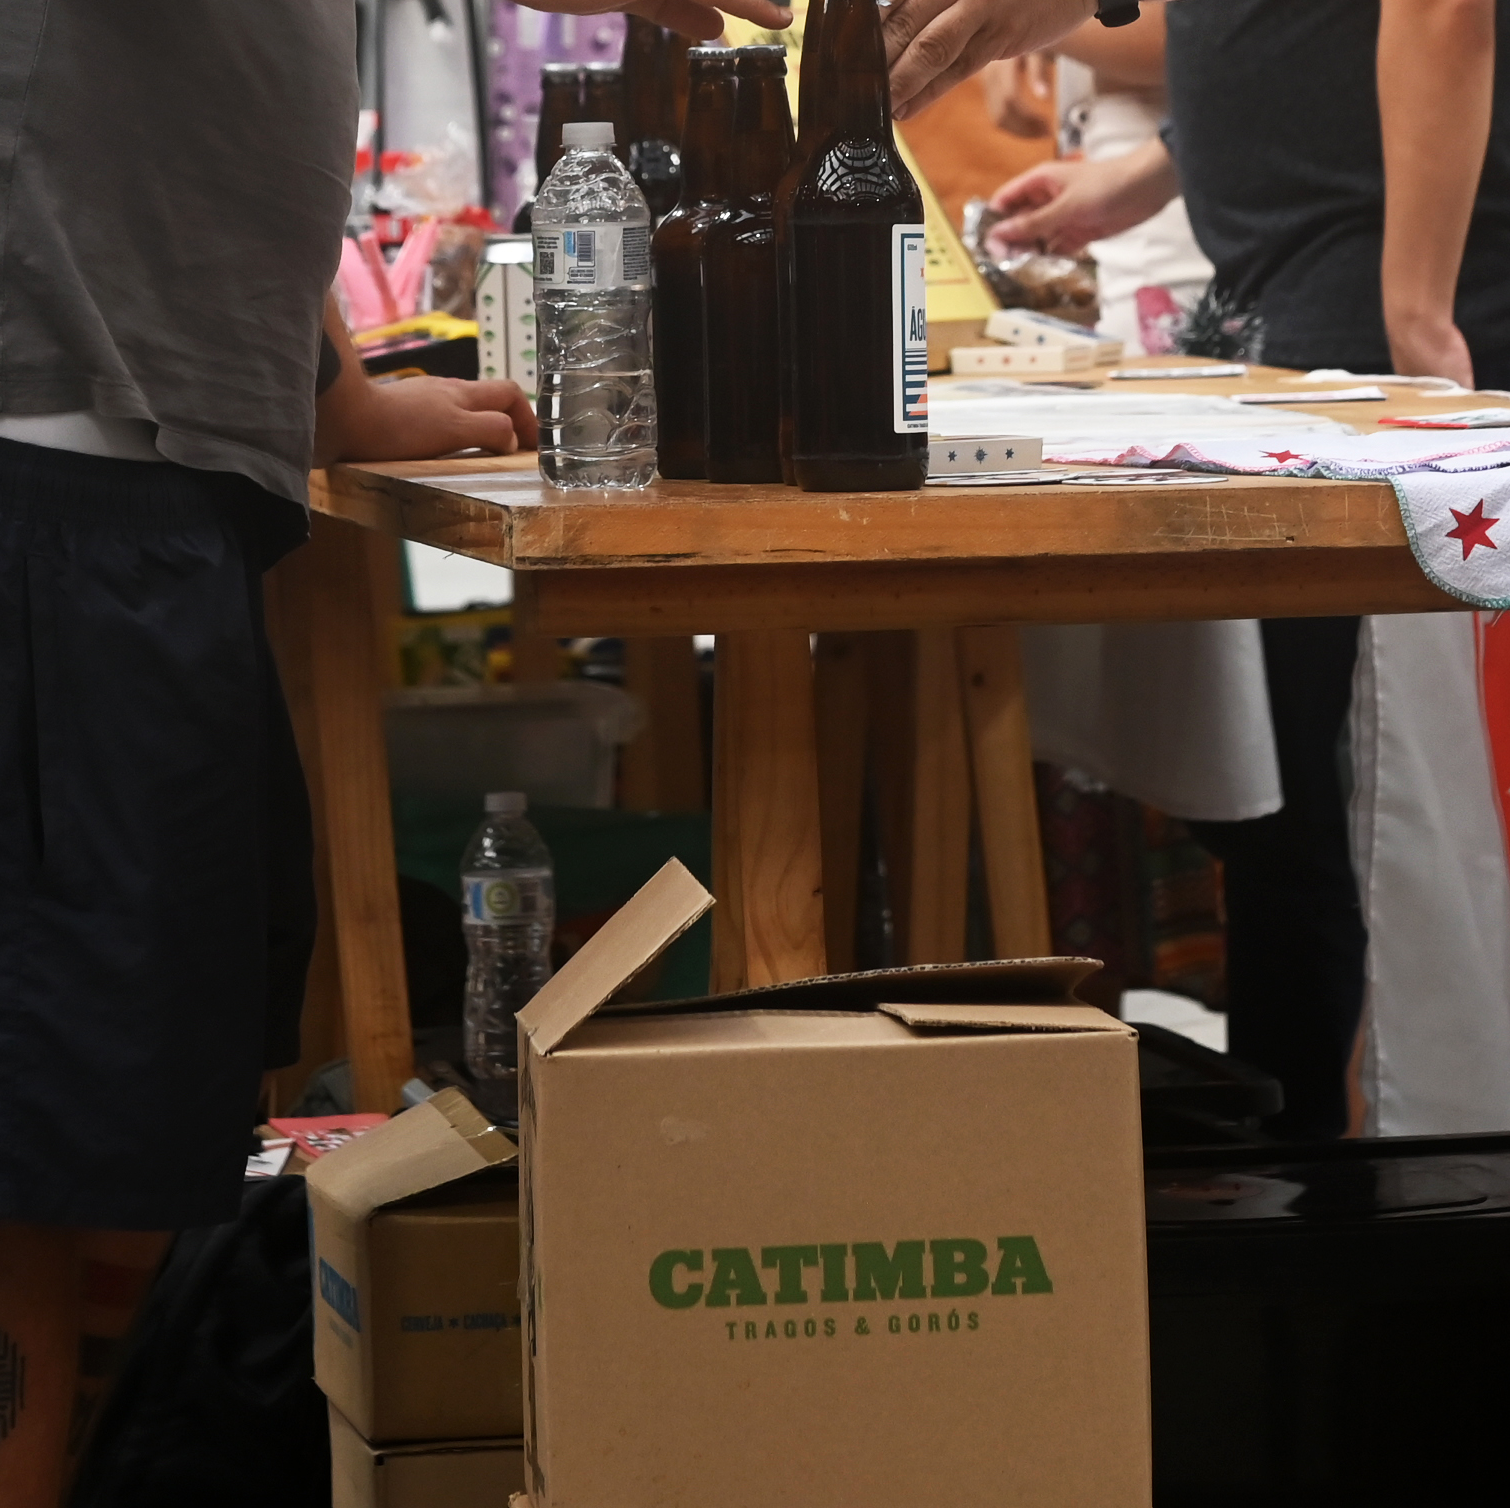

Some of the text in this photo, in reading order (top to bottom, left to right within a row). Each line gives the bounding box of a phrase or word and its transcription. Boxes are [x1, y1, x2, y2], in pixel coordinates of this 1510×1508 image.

[649, 1235, 1053, 1309] CATIMBA
[725, 1307, 980, 1341] TRAGOS & GORÓS
